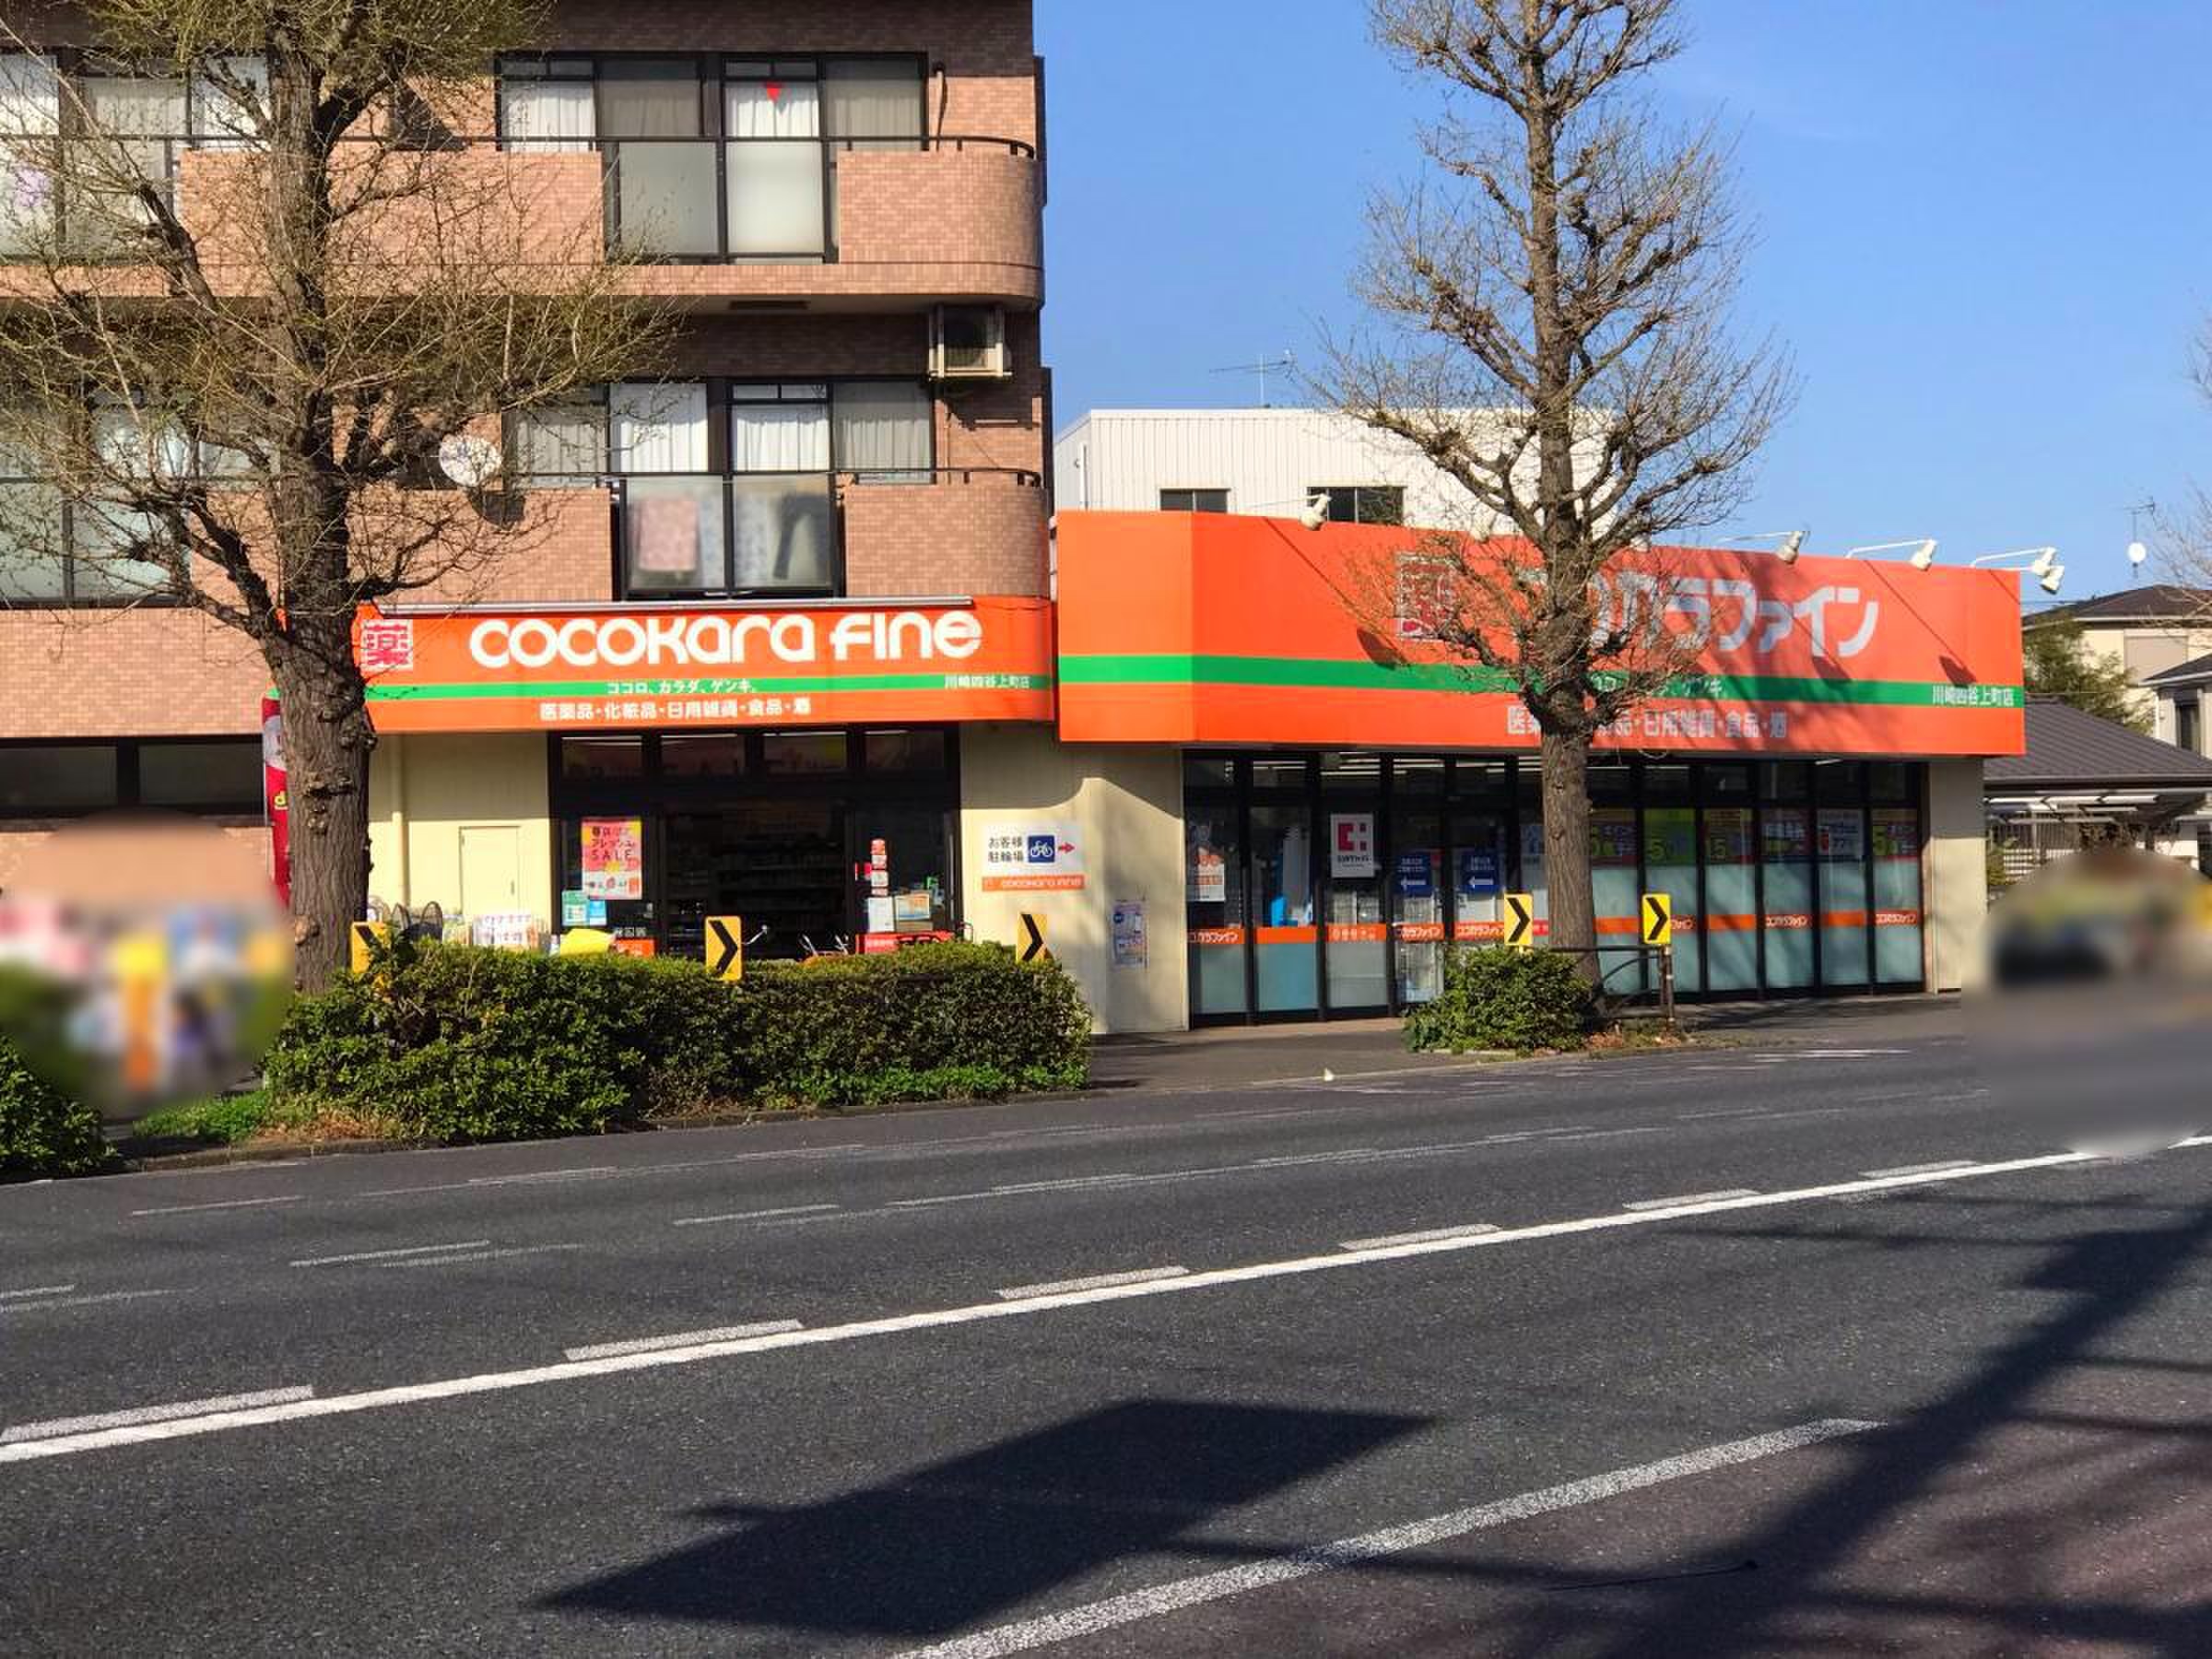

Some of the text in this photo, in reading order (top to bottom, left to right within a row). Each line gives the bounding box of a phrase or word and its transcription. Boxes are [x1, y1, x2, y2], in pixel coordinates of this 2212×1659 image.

[363, 619, 413, 670] 薬
[988, 836, 1023, 849] お客様
[988, 851, 1025, 864] 駐輪場
